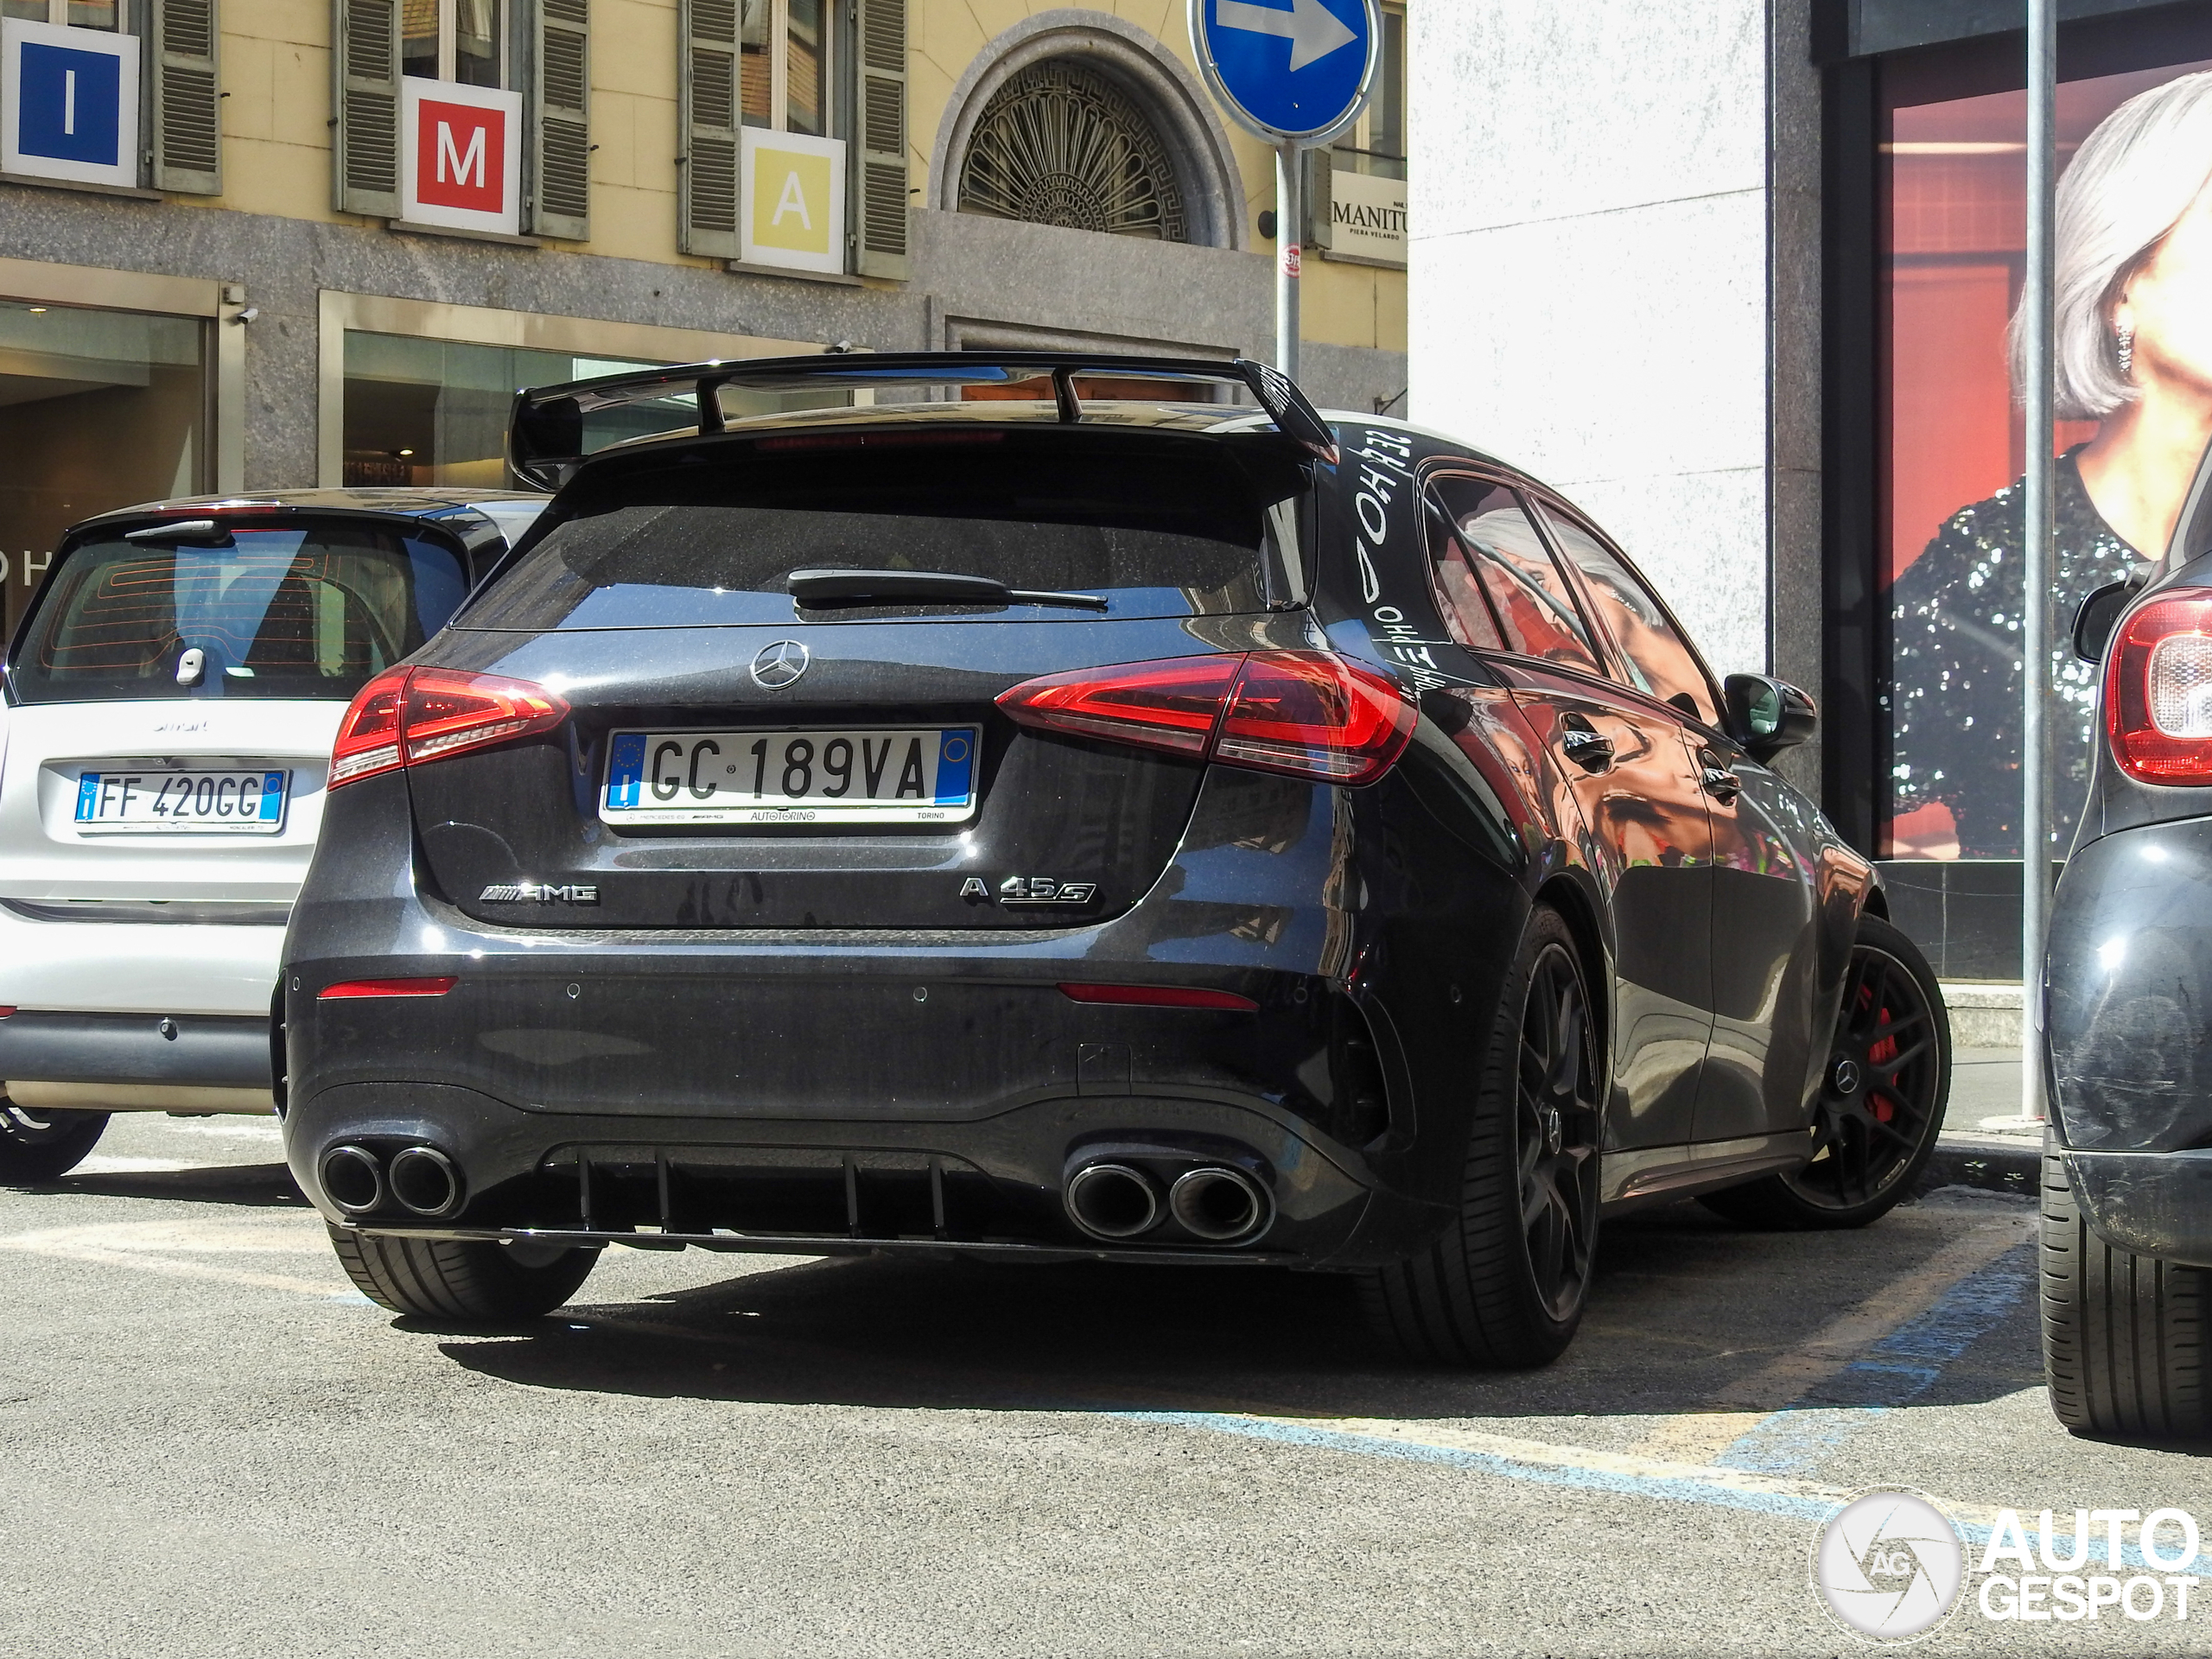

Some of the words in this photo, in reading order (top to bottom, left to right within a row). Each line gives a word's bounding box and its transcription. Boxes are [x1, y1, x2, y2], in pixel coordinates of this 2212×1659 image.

[435, 121, 486, 189] M
[772, 171, 811, 231] A
[652, 741, 720, 801] GC
[750, 738, 925, 799] 189VA
[99, 779, 142, 817] FF
[153, 777, 258, 817] 420GG
[751, 811, 816, 821] AUTOTORINO
[959, 877, 989, 897] A
